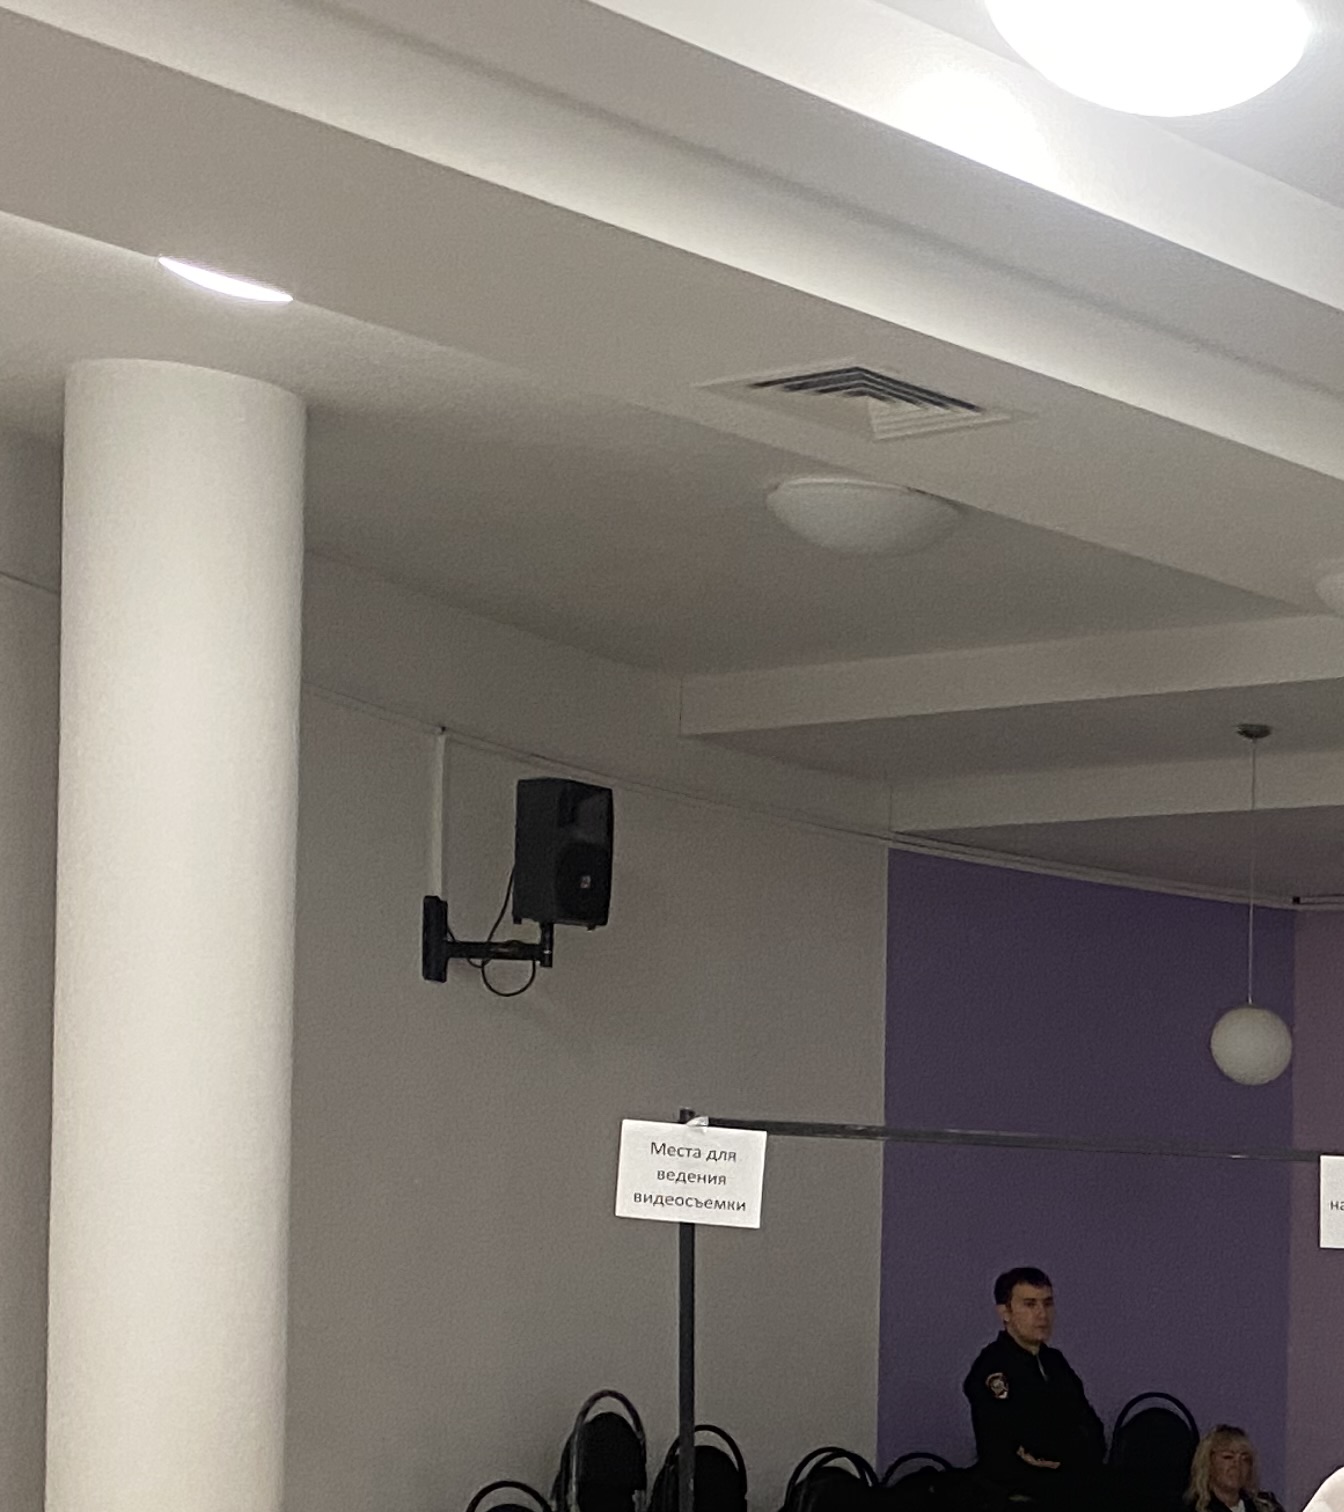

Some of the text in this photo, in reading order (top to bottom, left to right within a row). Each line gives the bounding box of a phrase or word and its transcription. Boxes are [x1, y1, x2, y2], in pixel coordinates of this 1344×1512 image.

[650, 1141, 737, 1163] Места для
[657, 1169, 727, 1185] ведения
[633, 1191, 747, 1212] видеосъемки
